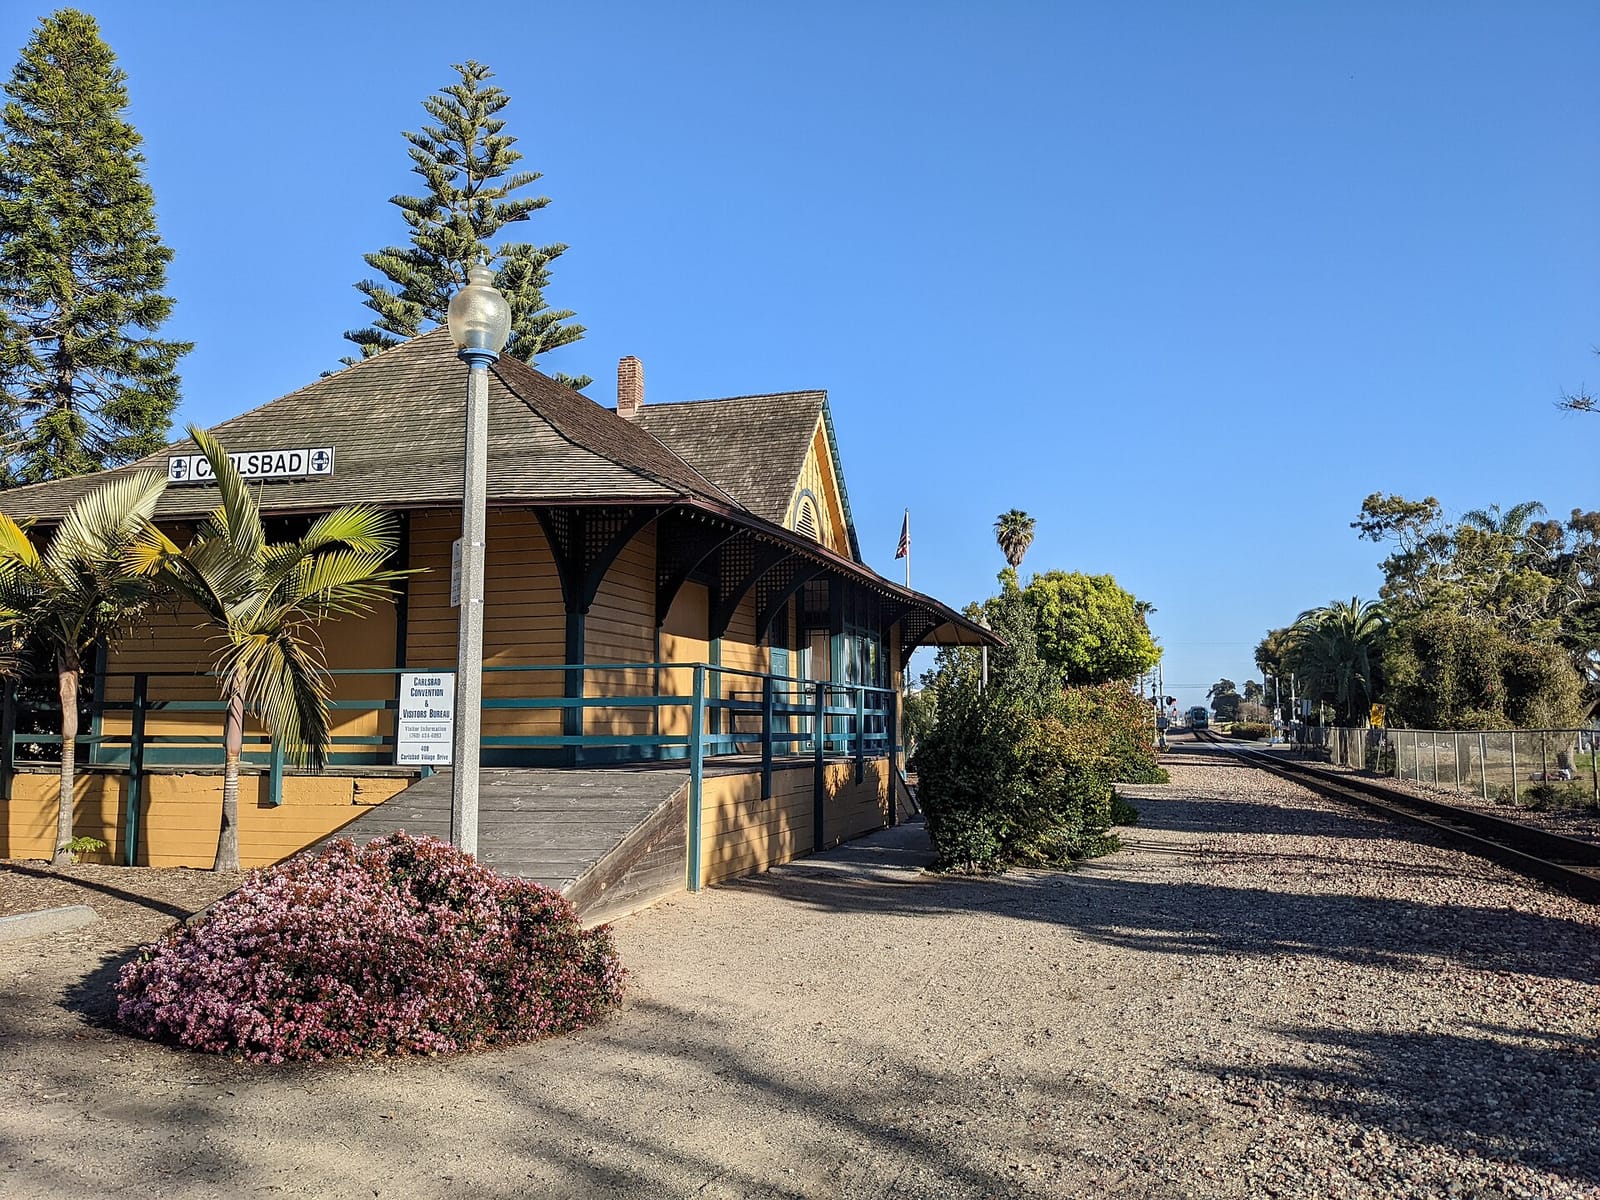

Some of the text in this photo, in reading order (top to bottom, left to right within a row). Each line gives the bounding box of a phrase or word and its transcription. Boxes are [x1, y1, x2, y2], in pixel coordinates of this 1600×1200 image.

[196, 453, 301, 477] CLSBAD
[414, 677, 441, 686] CARLSBAD
[411, 688, 443, 696] CONVENTION
[403, 709, 450, 718] VISITORS BUREAU
